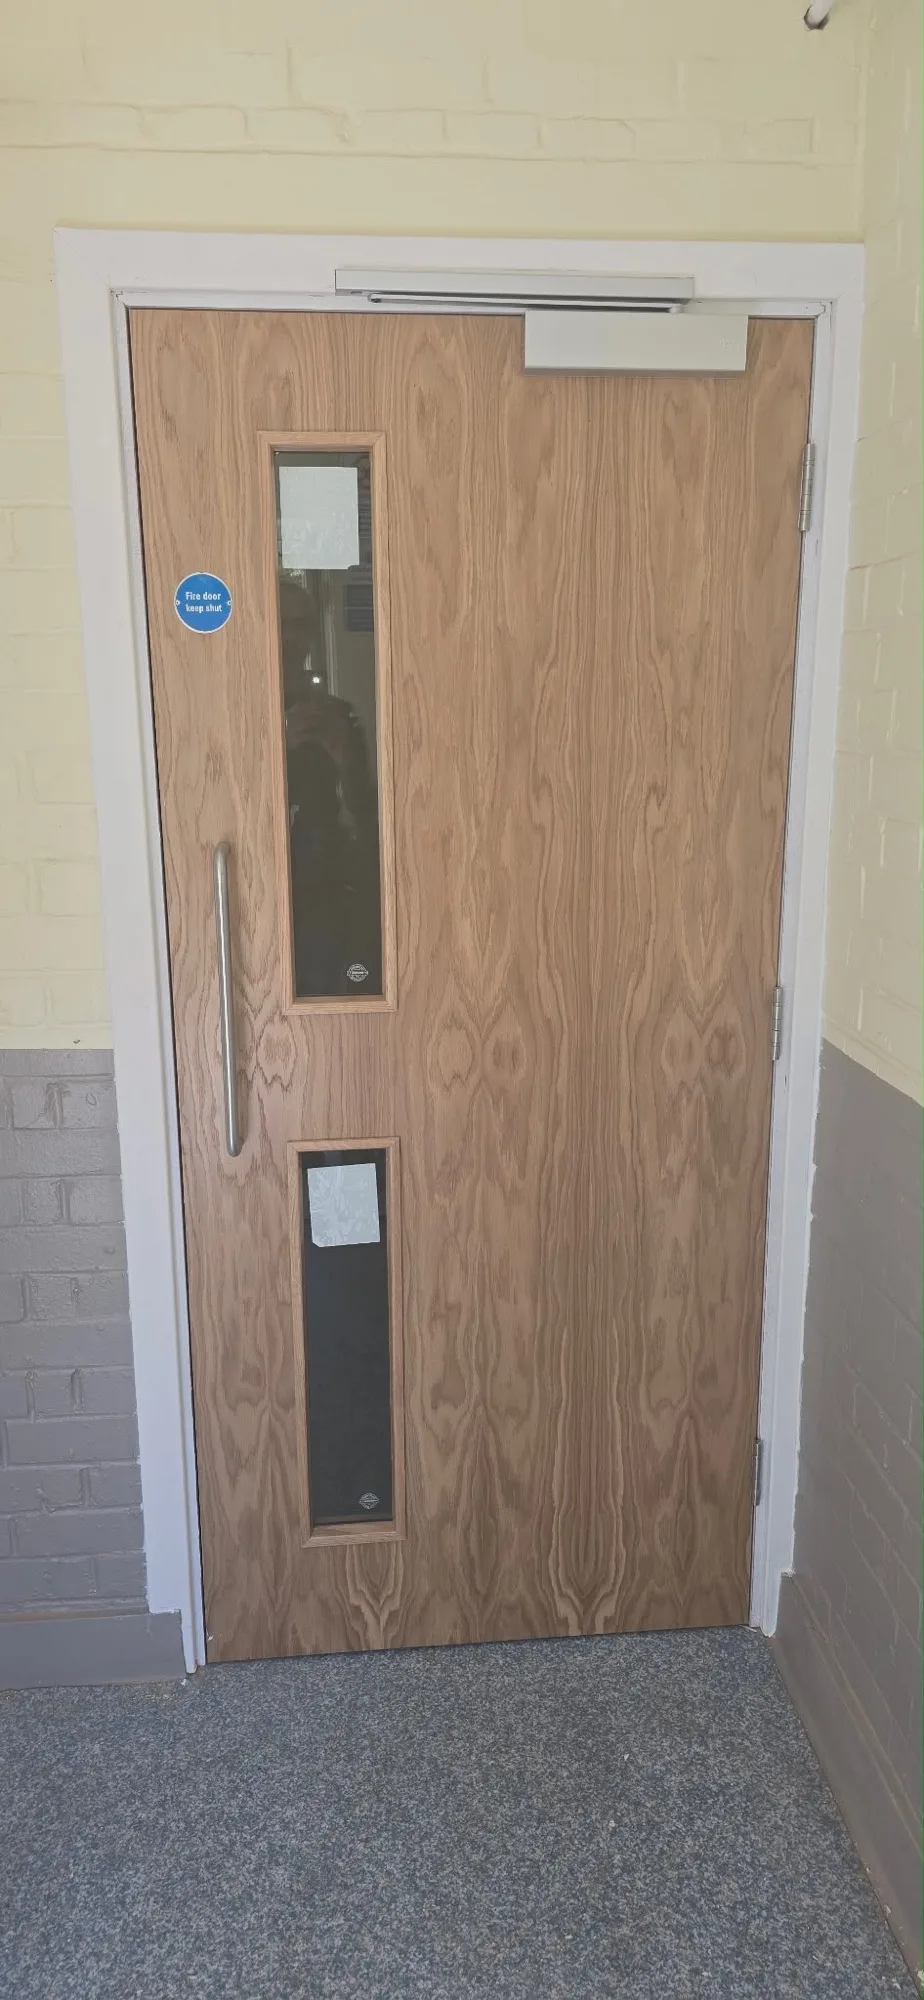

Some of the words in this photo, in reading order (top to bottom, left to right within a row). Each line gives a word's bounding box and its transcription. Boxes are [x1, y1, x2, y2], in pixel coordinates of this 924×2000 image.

[185, 591, 201, 600] Fire
[203, 591, 221, 600] door
[186, 604, 204, 614] keep
[206, 604, 222, 612] shut
